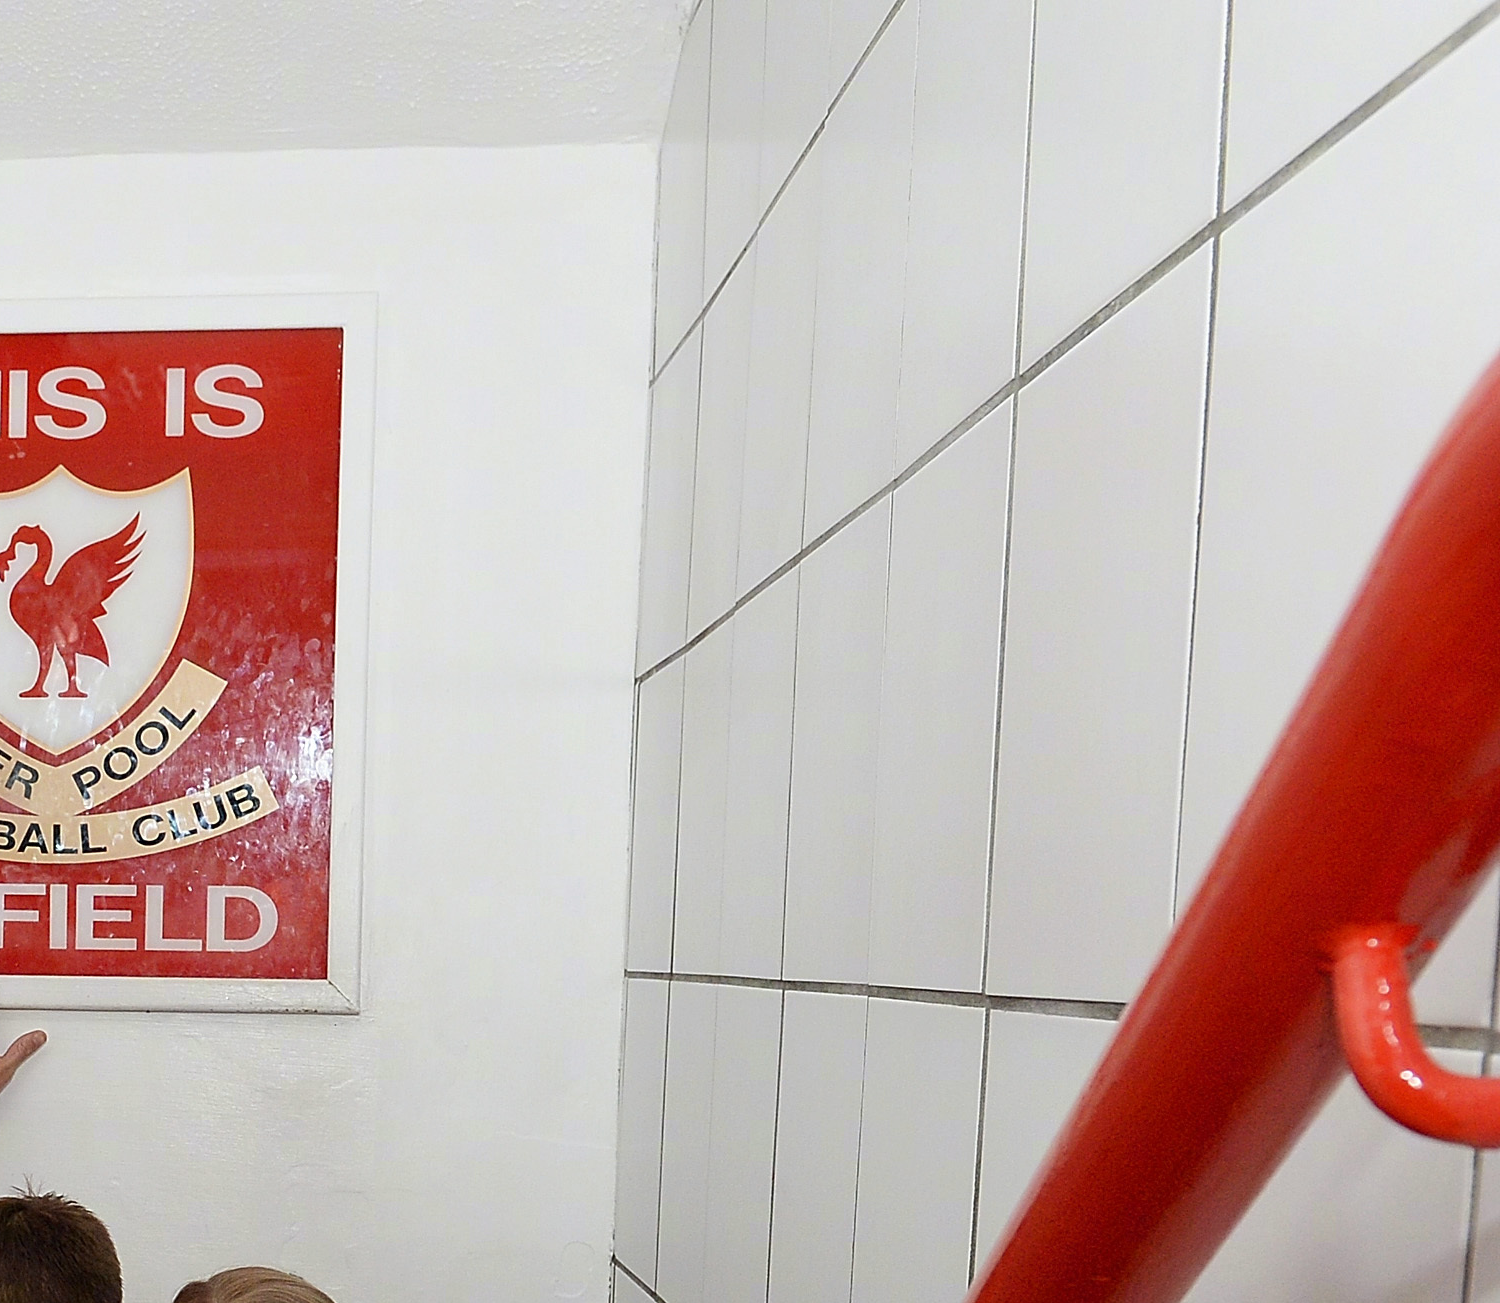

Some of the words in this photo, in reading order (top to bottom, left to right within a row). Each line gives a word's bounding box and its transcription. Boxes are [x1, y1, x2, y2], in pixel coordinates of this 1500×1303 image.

[165, 364, 266, 439] IS
[71, 706, 197, 801] POOL
[132, 783, 261, 846] CLUB
